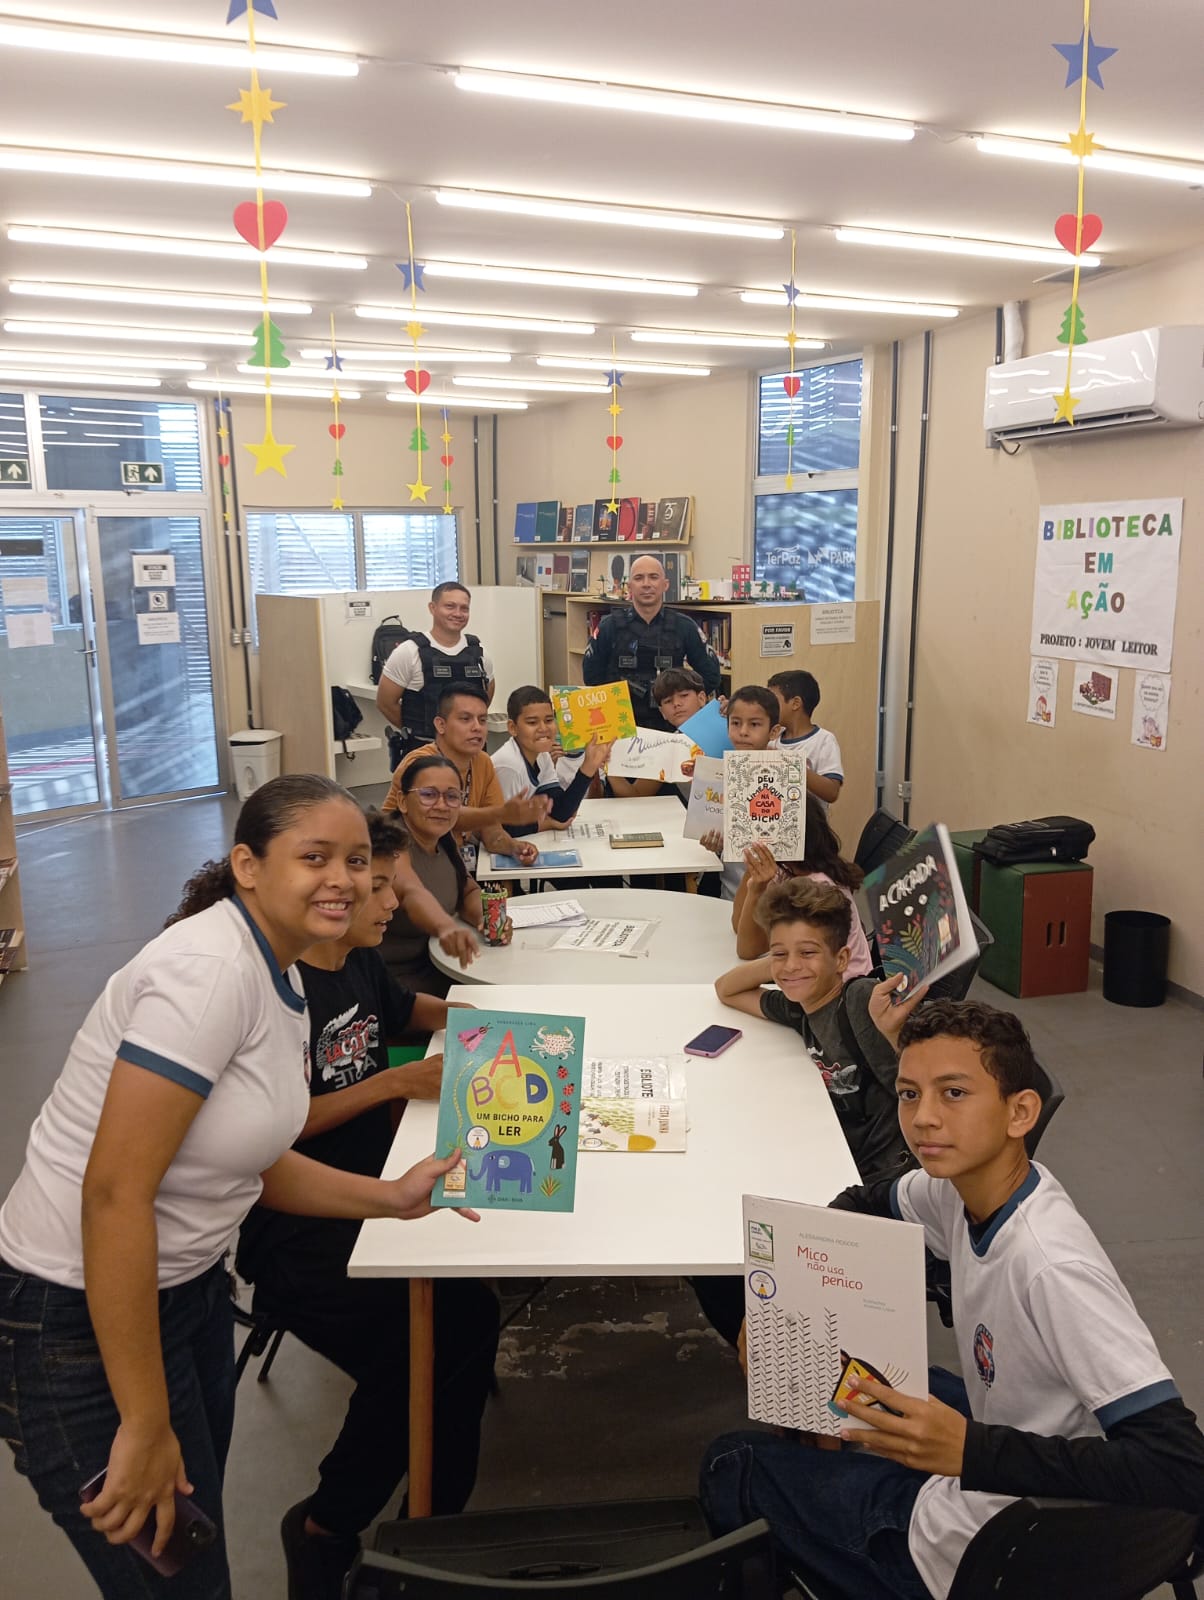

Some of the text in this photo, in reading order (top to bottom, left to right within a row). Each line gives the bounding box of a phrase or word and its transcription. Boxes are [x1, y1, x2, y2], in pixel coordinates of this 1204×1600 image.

[1043, 513, 1173, 540] BIBLIOTECA
[765, 551, 800, 565] TerPaz
[1084, 552, 1113, 573] EM
[1066, 582, 1125, 619] AÇÃO
[1040, 633, 1076, 648] PROJETO
[1084, 637, 1115, 651] JOVEM
[1121, 640, 1158, 656] LEITOR
[577, 690, 607, 708] O SACO
[757, 775, 774, 783] DEU
[751, 812, 780, 823] BICHO
[488, 1028, 522, 1078] A
[476, 1112, 544, 1123] UM BICHO PARA
[498, 1125, 521, 1137] LER
[797, 1245, 829, 1263] Mico
[807, 1261, 845, 1276] não usa
[822, 1274, 863, 1291] penico
